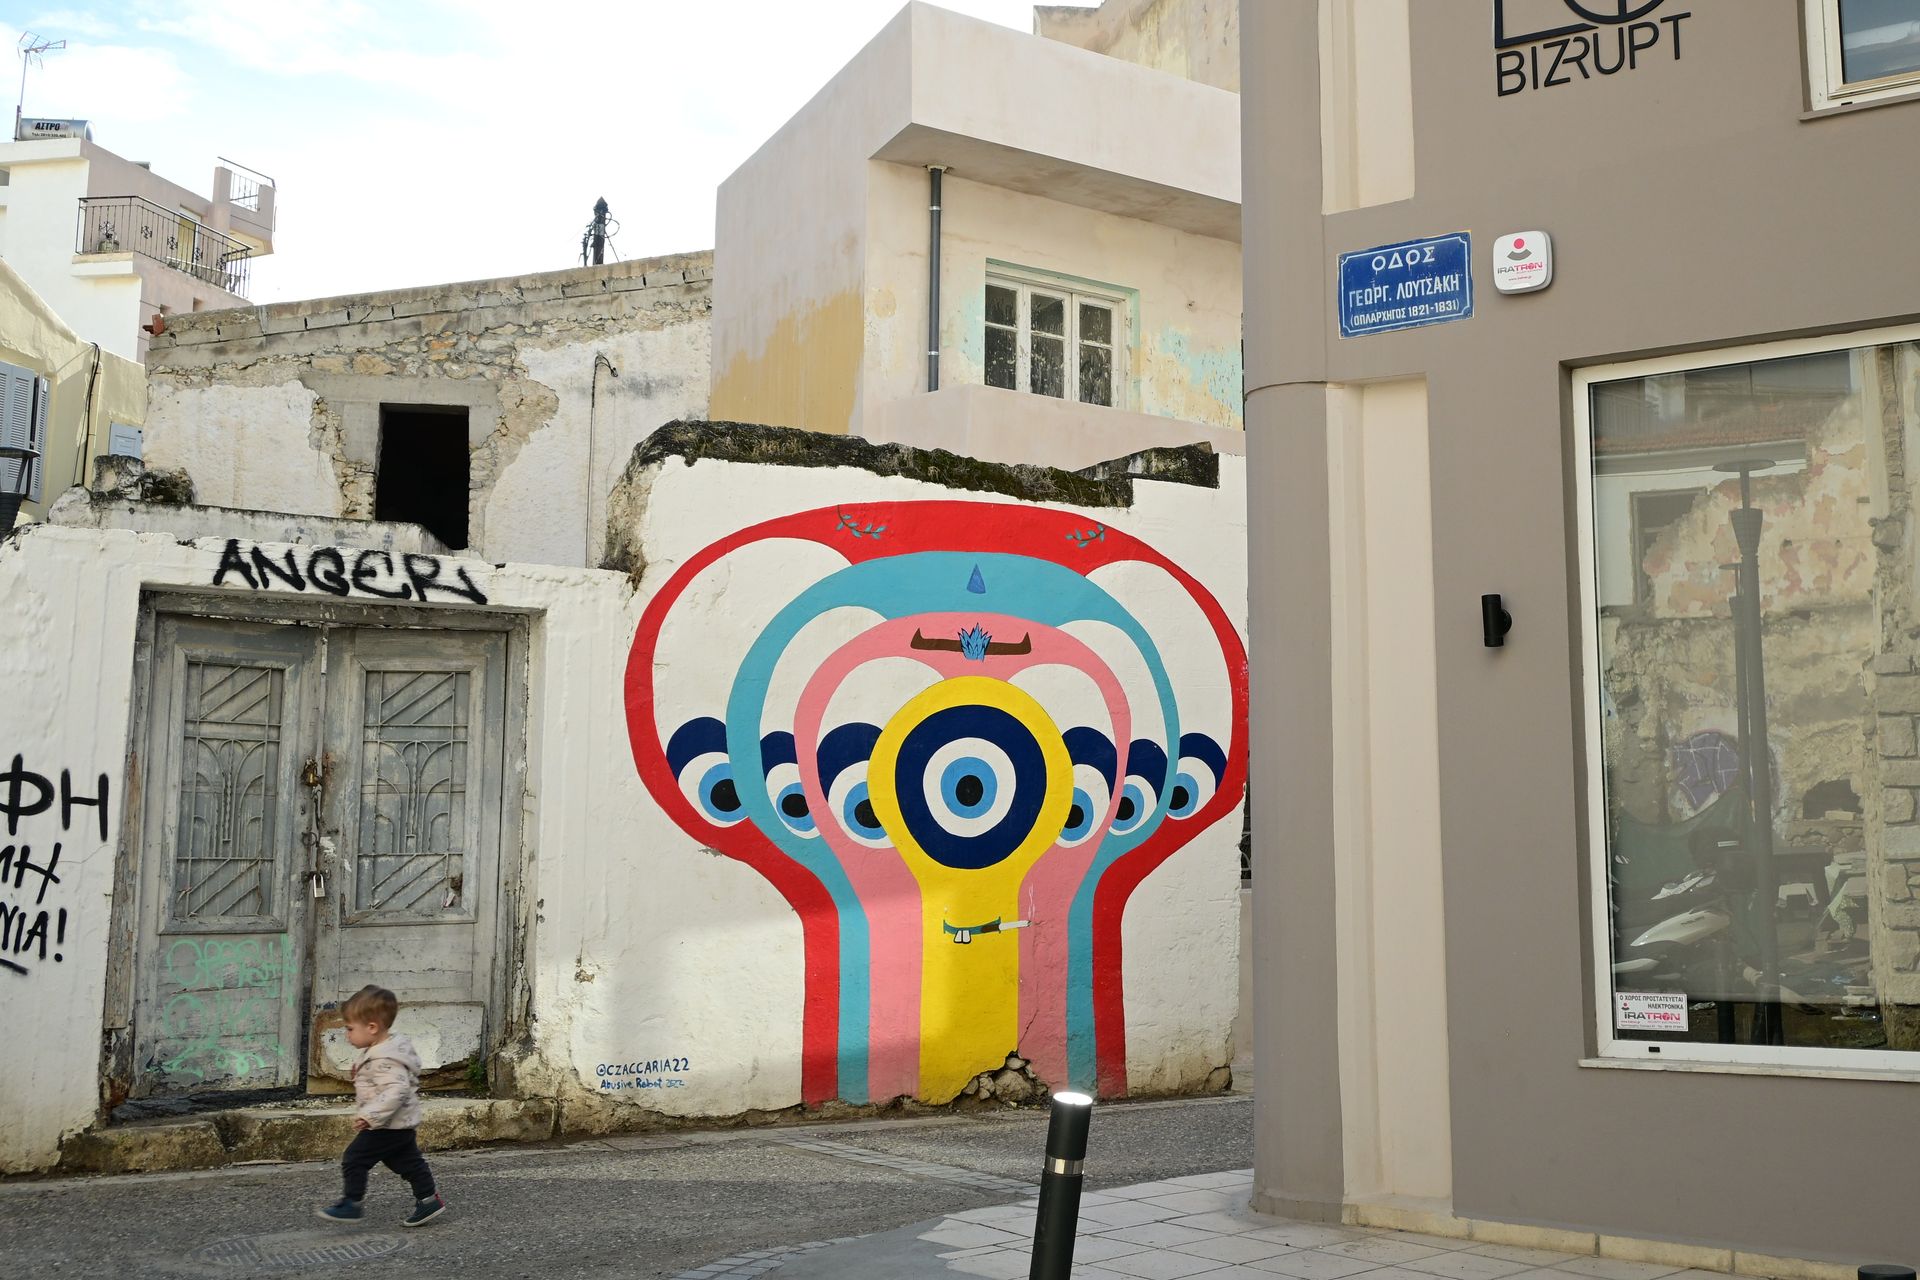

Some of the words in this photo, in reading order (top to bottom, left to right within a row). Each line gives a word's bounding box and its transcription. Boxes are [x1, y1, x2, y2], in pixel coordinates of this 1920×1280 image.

[1496, 12, 1691, 97] BIZRUPT
[1372, 246, 1435, 271] ΟΔΟΣ
[1349, 285, 1392, 307] ΓΕΩΡΓ.
[1396, 273, 1460, 300] ΛΟΥΤΣΑΚΗ
[1350, 307, 1406, 327] (ΟΠΛΑΡΧΗΓΟΣ
[1408, 298, 1460, 317] 1821-1831)
[596, 1057, 690, 1077] @CZACCARIA22
[600, 1079, 633, 1090] Abusive
[635, 1077, 662, 1090] Robot
